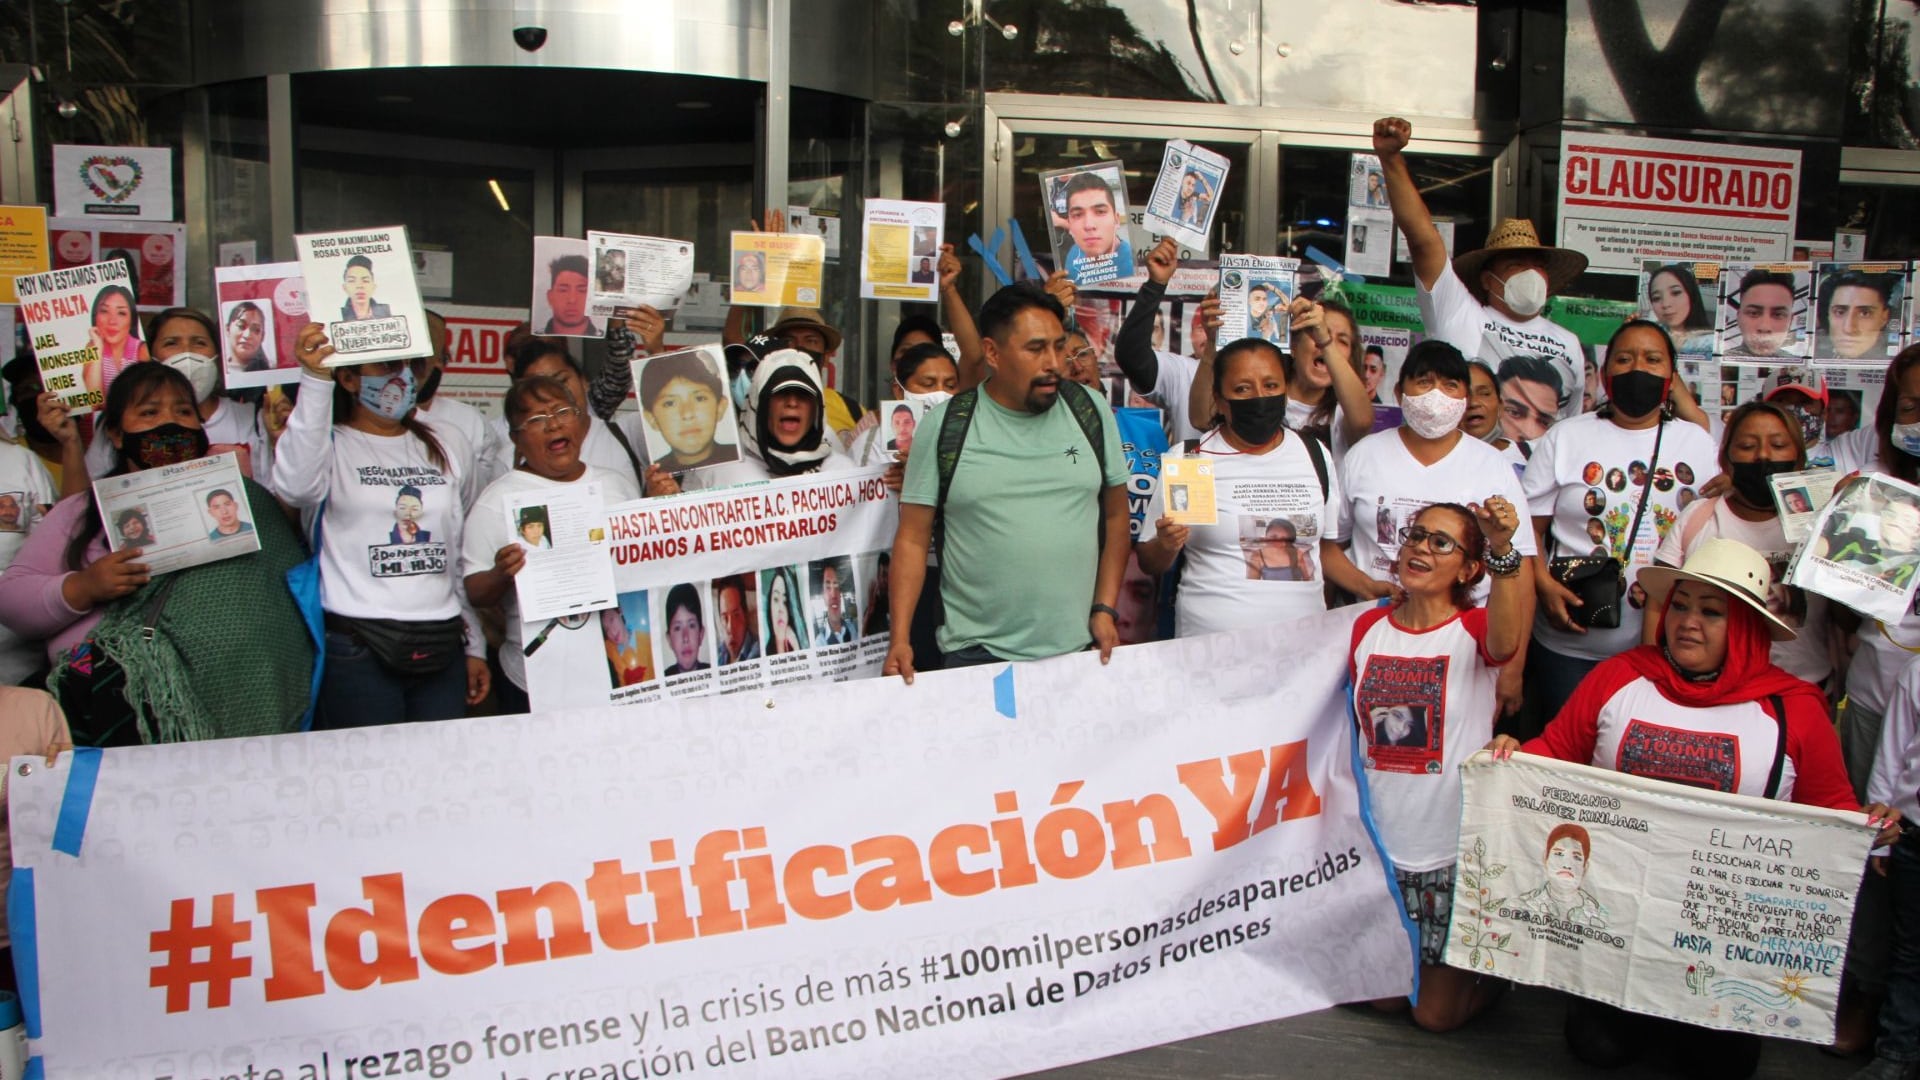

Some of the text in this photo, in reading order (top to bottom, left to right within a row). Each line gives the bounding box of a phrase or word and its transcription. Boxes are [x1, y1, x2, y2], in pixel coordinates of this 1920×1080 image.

[1565, 155, 1793, 210] CLAUSURADO
[311, 233, 390, 248] DIEGO MAXIMILIANO
[1595, 236, 1606, 244] que
[1664, 229, 1671, 237] de
[1680, 230, 1698, 240] Banco
[1700, 232, 1724, 242] Nacional
[1725, 234, 1732, 242] de
[313, 244, 392, 259] ROSAS VALENZUELA
[1080, 260, 1114, 270] ARMANDO
[16, 262, 128, 296] HOY NO ESTAMOS TODAS
[24, 294, 89, 324] NOS FALTA
[34, 334, 60, 350] JAEL
[39, 347, 100, 371] MONSERRAT
[45, 374, 76, 392] URIBE
[56, 390, 104, 409] MEROS
[609, 513, 660, 541] HASTA
[662, 496, 761, 534] ENCONTRARTE
[764, 496, 790, 518] A.C.
[792, 483, 857, 516] PACHUCA,
[858, 477, 889, 504] HGO.
[693, 534, 706, 553] A
[710, 514, 837, 550] ENCONTRARLOS
[380, 562, 402, 574] MI
[1543, 786, 1621, 810] FERNANDO
[1512, 795, 1648, 833] VALADEZ KINIJARA
[1709, 828, 1793, 859] EL MAR
[1690, 866, 1706, 878] DEL
[1708, 868, 1728, 881] MAR
[1732, 872, 1742, 884] ES
[1789, 884, 1801, 893] TU
[1692, 850, 1821, 881] EL ESCUCHAR LAS OLAS
[1686, 880, 1828, 912] AUN SIGUES DESAPARECIDO
[1686, 890, 1842, 926] PERO YO TE ENCUENTRO CADA
[1499, 908, 1625, 949] DESAPARECIDO
[1680, 909, 1824, 943] CON EMOCION APRETANDO
[1682, 900, 1835, 936] QUE TE PIENSO Y TE HABLO
[1674, 931, 1835, 978] HASTA ENCONTRARTE
[1718, 926, 1760, 943] DENTRO
[1760, 935, 1840, 961] HERMANO
[299, 1052, 330, 1080] al
[344, 1038, 473, 1079] rezago
[482, 1012, 622, 1061] forense
[630, 1012, 650, 1045] y
[660, 998, 690, 1030] la
[700, 984, 786, 1024] crisis
[795, 974, 834, 1008] de
[844, 962, 912, 999] más
[920, 844, 1362, 985] #100milpersonasdesaparecidas
[705, 1030, 757, 1068] del
[764, 1017, 867, 1057] Banco
[875, 981, 1016, 1036] Nacional
[1025, 975, 1065, 1008] de
[1072, 956, 1151, 998] Datos
[1158, 914, 1272, 970] Forenses
